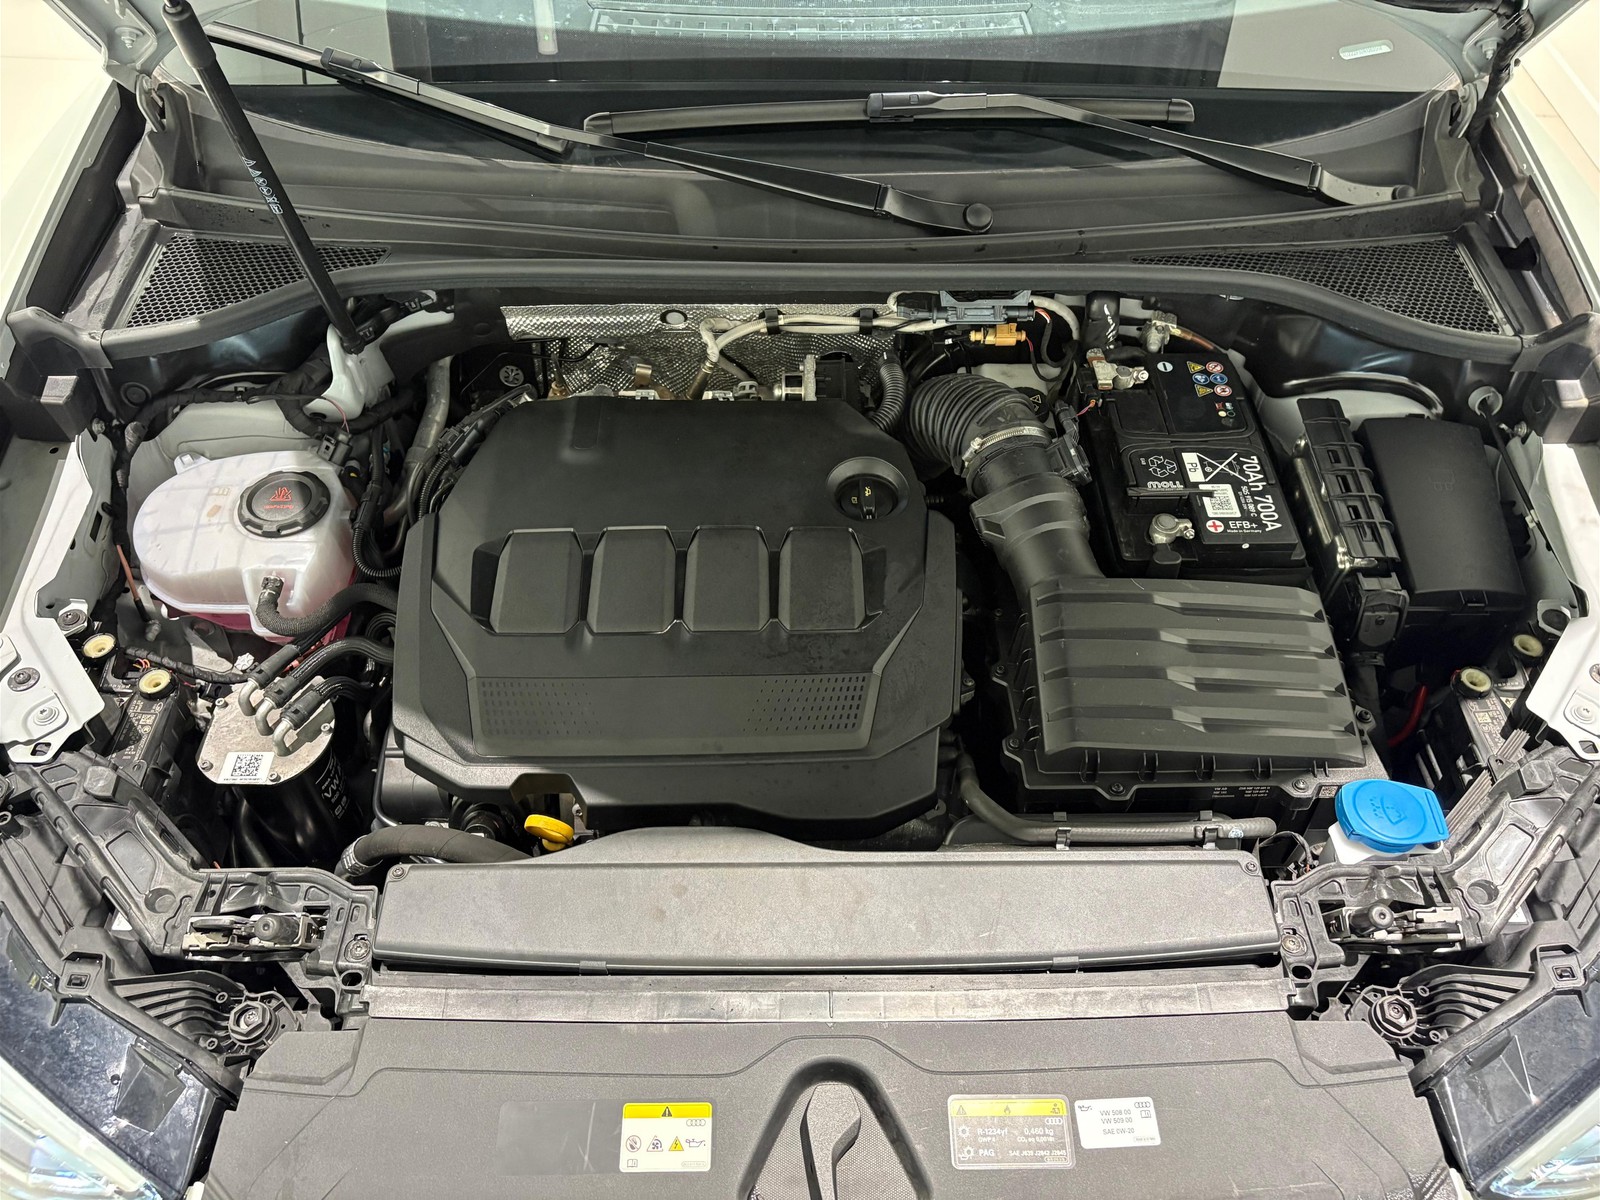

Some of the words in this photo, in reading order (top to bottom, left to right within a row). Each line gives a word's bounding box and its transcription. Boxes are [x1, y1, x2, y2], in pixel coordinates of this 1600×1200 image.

[1186, 462, 1197, 473] Pb
[1239, 455, 1267, 491] 70Ah
[1254, 495, 1282, 532] 700A
[1228, 520, 1258, 529] EFB+
[977, 1128, 1008, 1137] R-1234yf
[1044, 1127, 1054, 1136] kg
[1116, 1127, 1135, 1135] 0W-20
[979, 1149, 995, 1157] PAG
